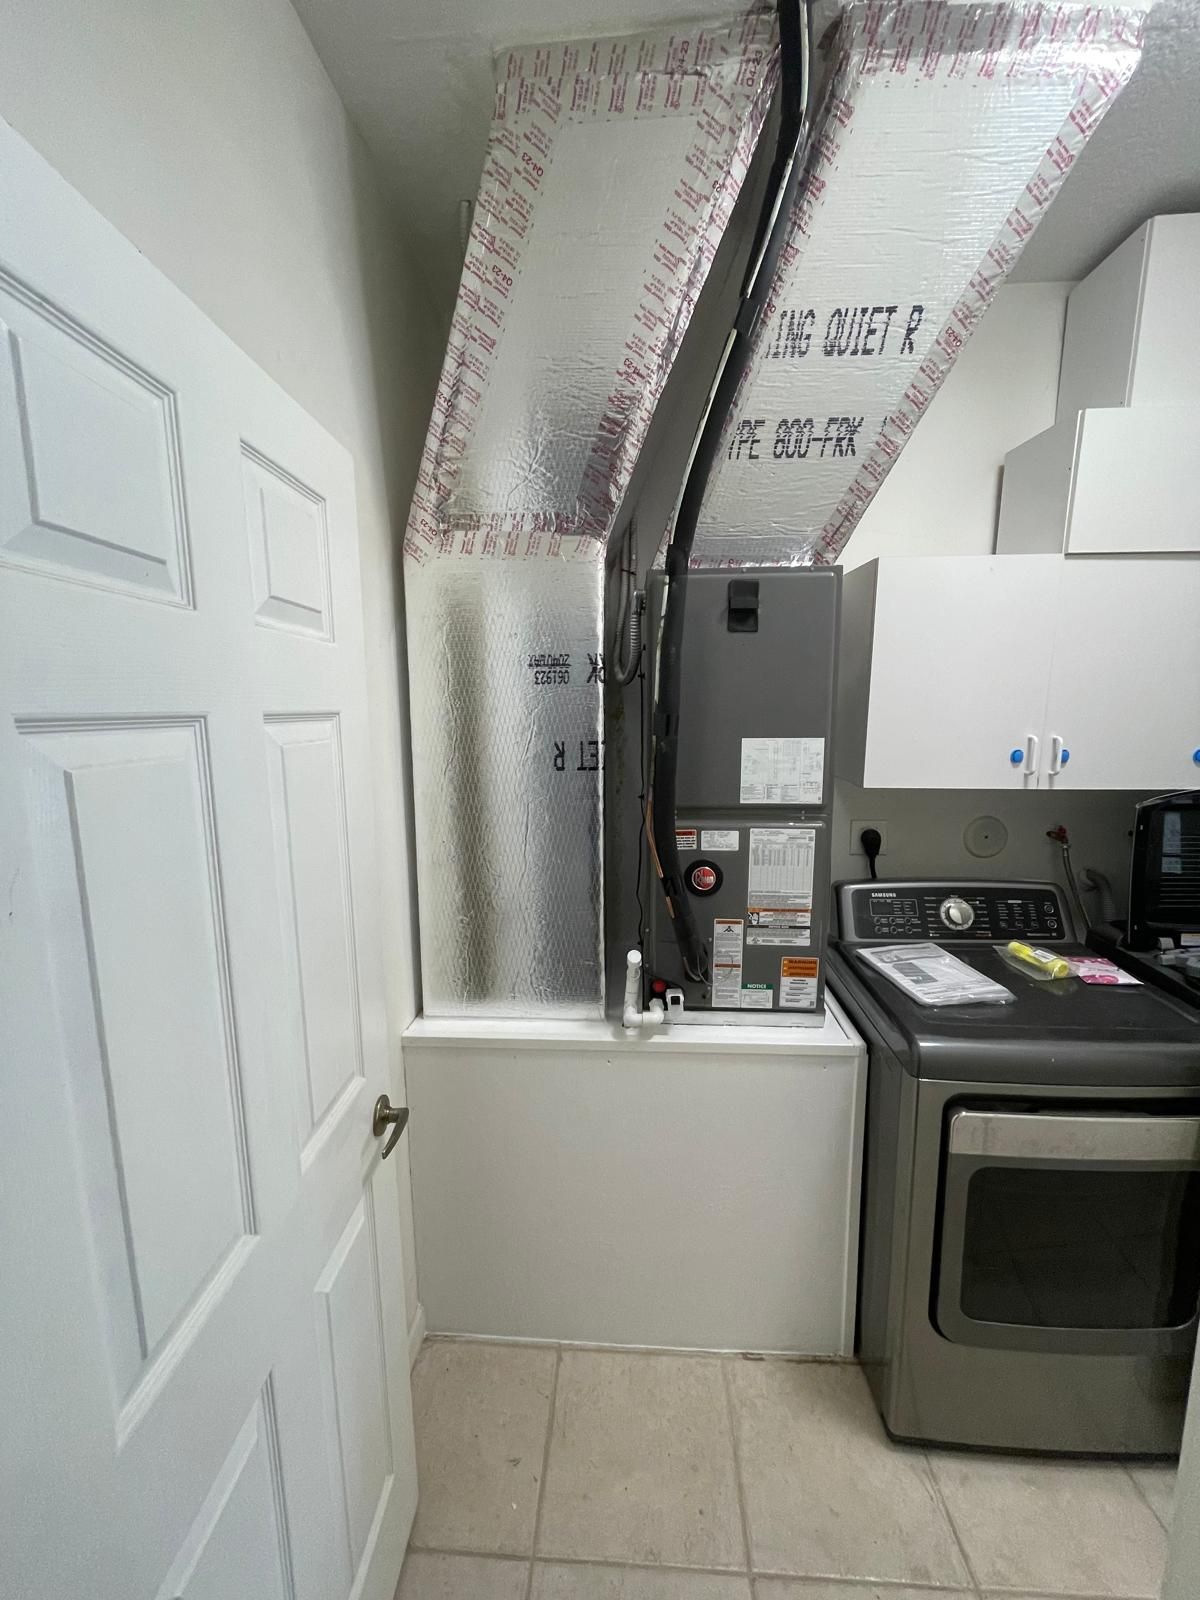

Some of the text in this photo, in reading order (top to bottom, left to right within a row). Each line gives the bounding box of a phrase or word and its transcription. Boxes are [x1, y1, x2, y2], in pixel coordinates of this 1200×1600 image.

[491, 264, 513, 287] Q4-23
[823, 305, 899, 357] QUIET
[900, 304, 924, 355] R
[553, 740, 565, 771] R
